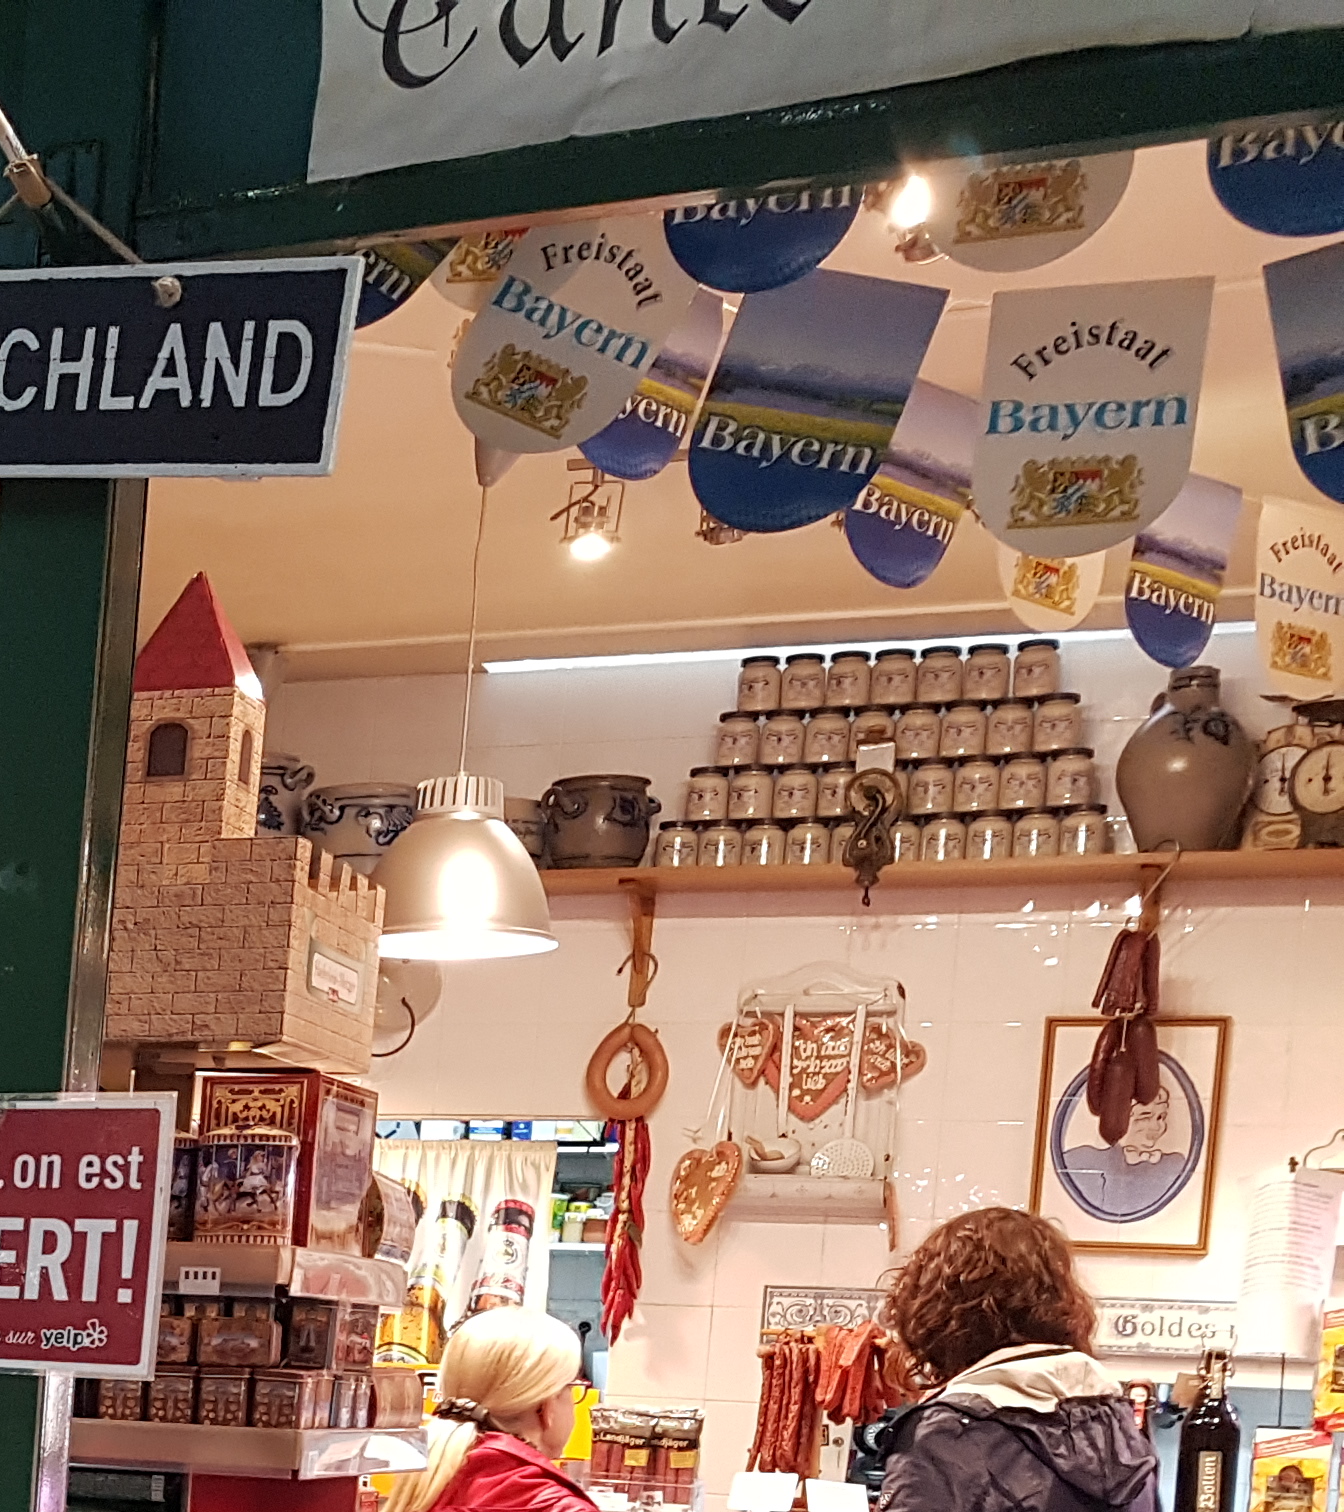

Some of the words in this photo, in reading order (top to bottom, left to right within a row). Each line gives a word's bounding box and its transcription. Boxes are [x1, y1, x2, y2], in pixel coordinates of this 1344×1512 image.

[540, 232, 664, 312] Freistaat
[490, 273, 657, 371] Bayern
[1010, 317, 1175, 384] Freistaat
[617, 394, 689, 439] yern
[985, 392, 1191, 440] Bayern
[696, 413, 877, 475] Bayern
[850, 481, 956, 545] Bayern
[1129, 568, 1216, 628] Bayern
[14, 1153, 62, 1189] on
[78, 1145, 144, 1191] est
[5, 1331, 35, 1346] sur
[41, 1327, 84, 1350] yelp
[599, 1432, 646, 1448] Landjäger
[651, 1437, 689, 1449] ndjäger
